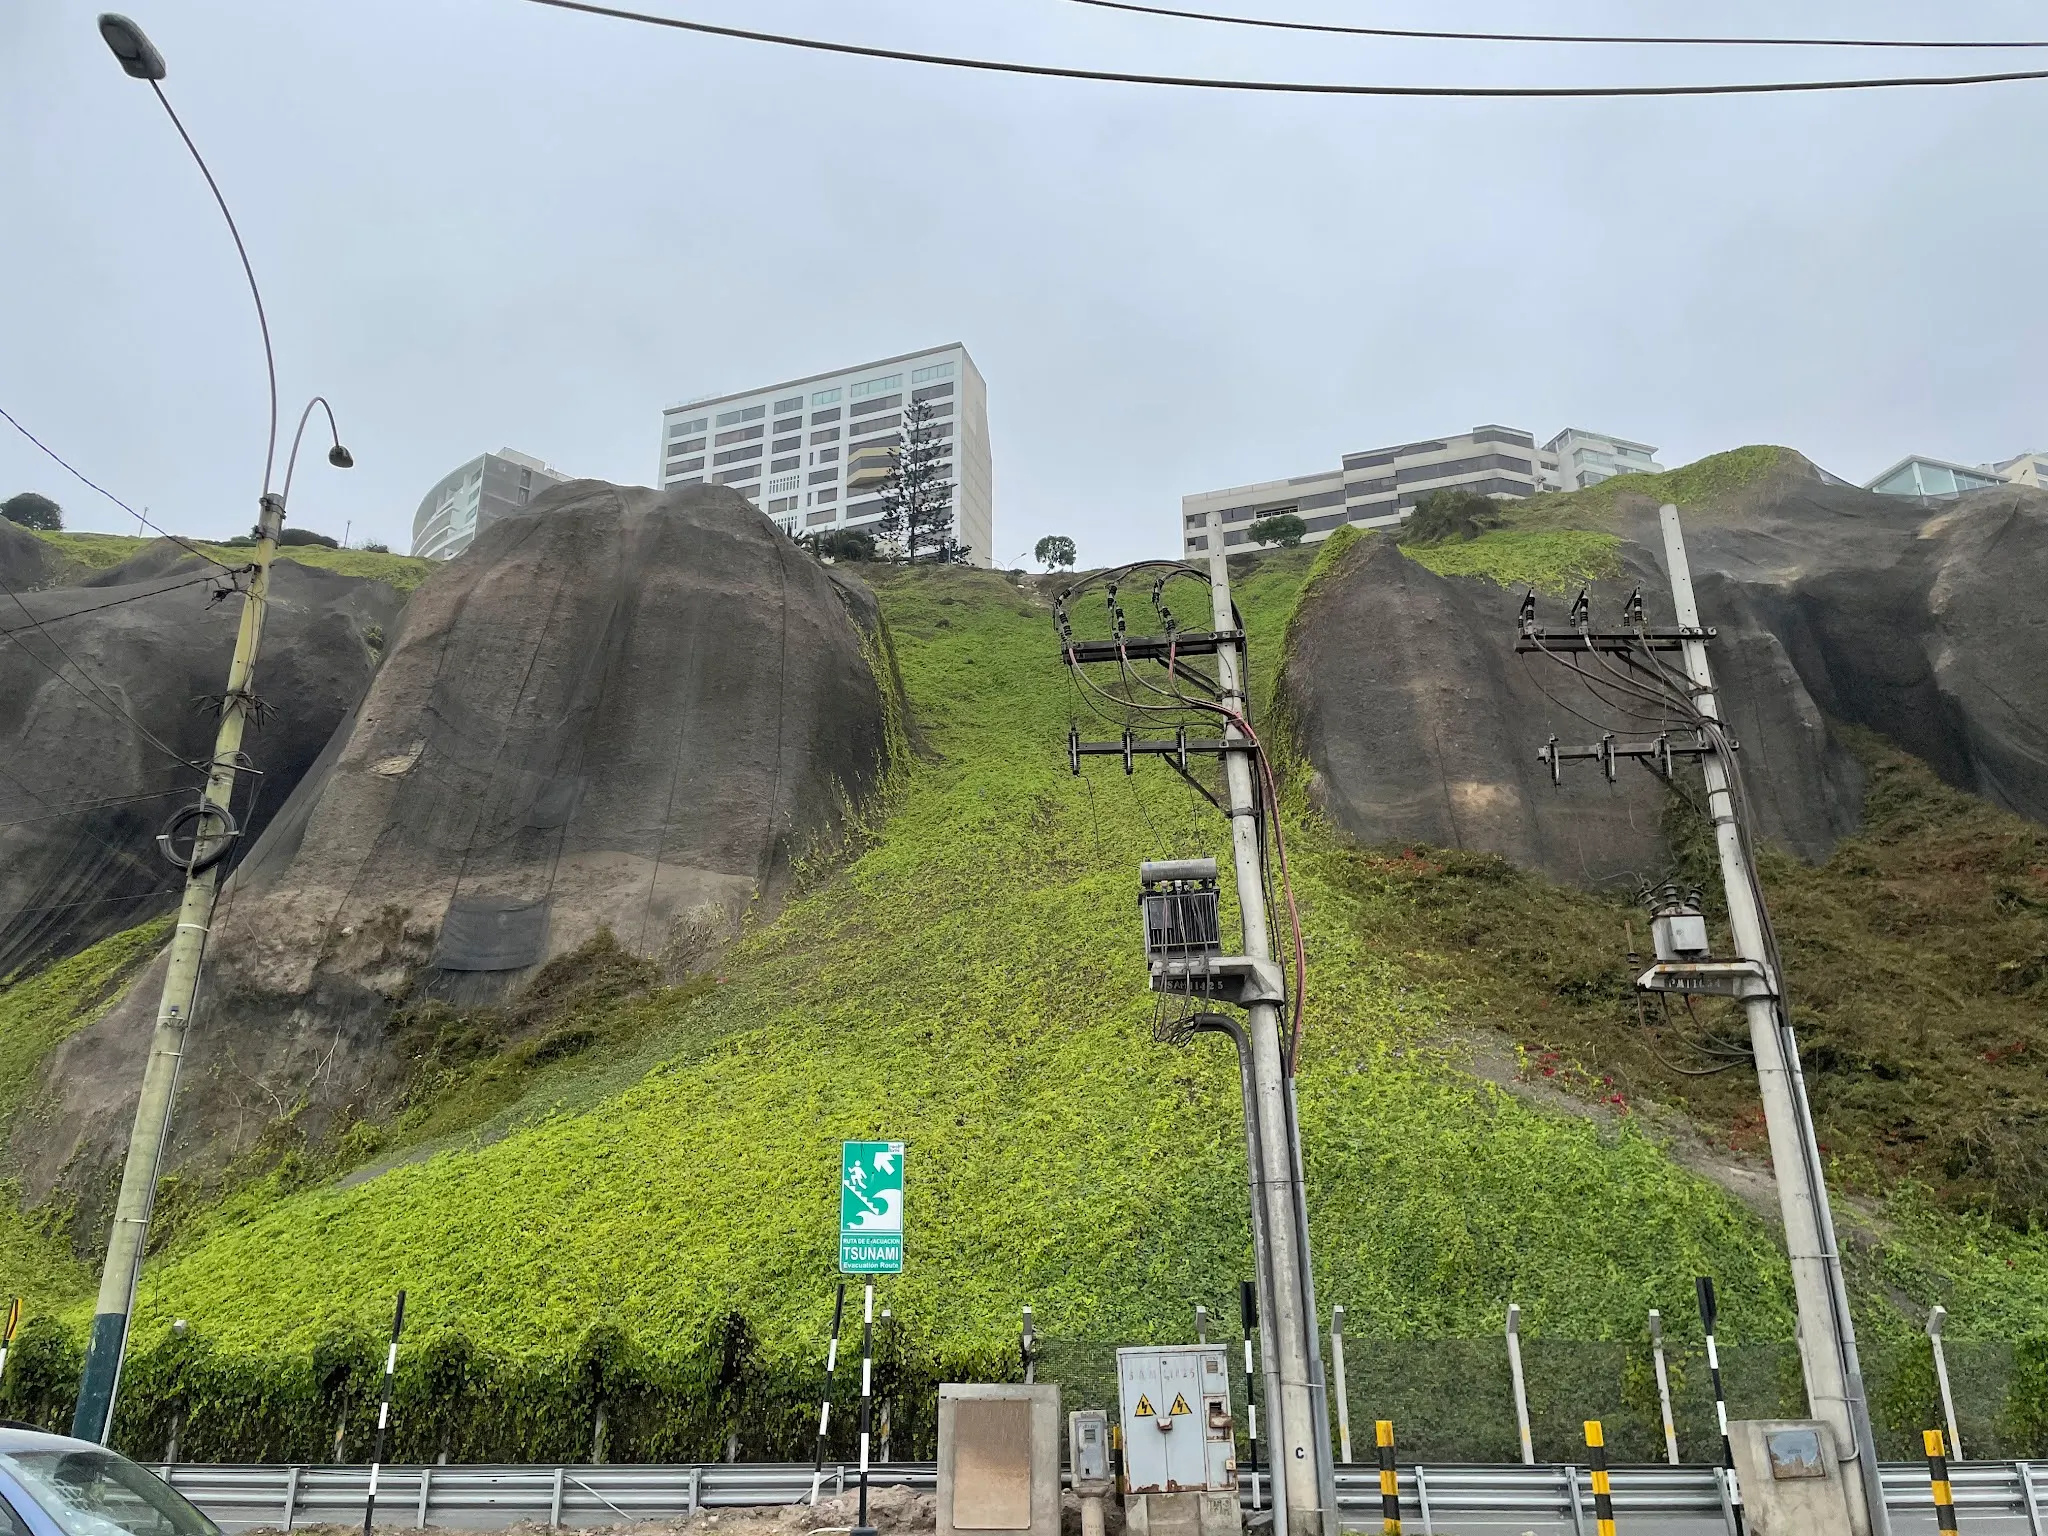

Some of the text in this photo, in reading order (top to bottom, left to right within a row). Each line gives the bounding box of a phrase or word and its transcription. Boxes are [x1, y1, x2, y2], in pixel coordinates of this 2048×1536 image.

[842, 1246, 899, 1261] TSUNAMI
[843, 1261, 899, 1269] Evacuation Route
[1295, 1446, 1305, 1460] C
